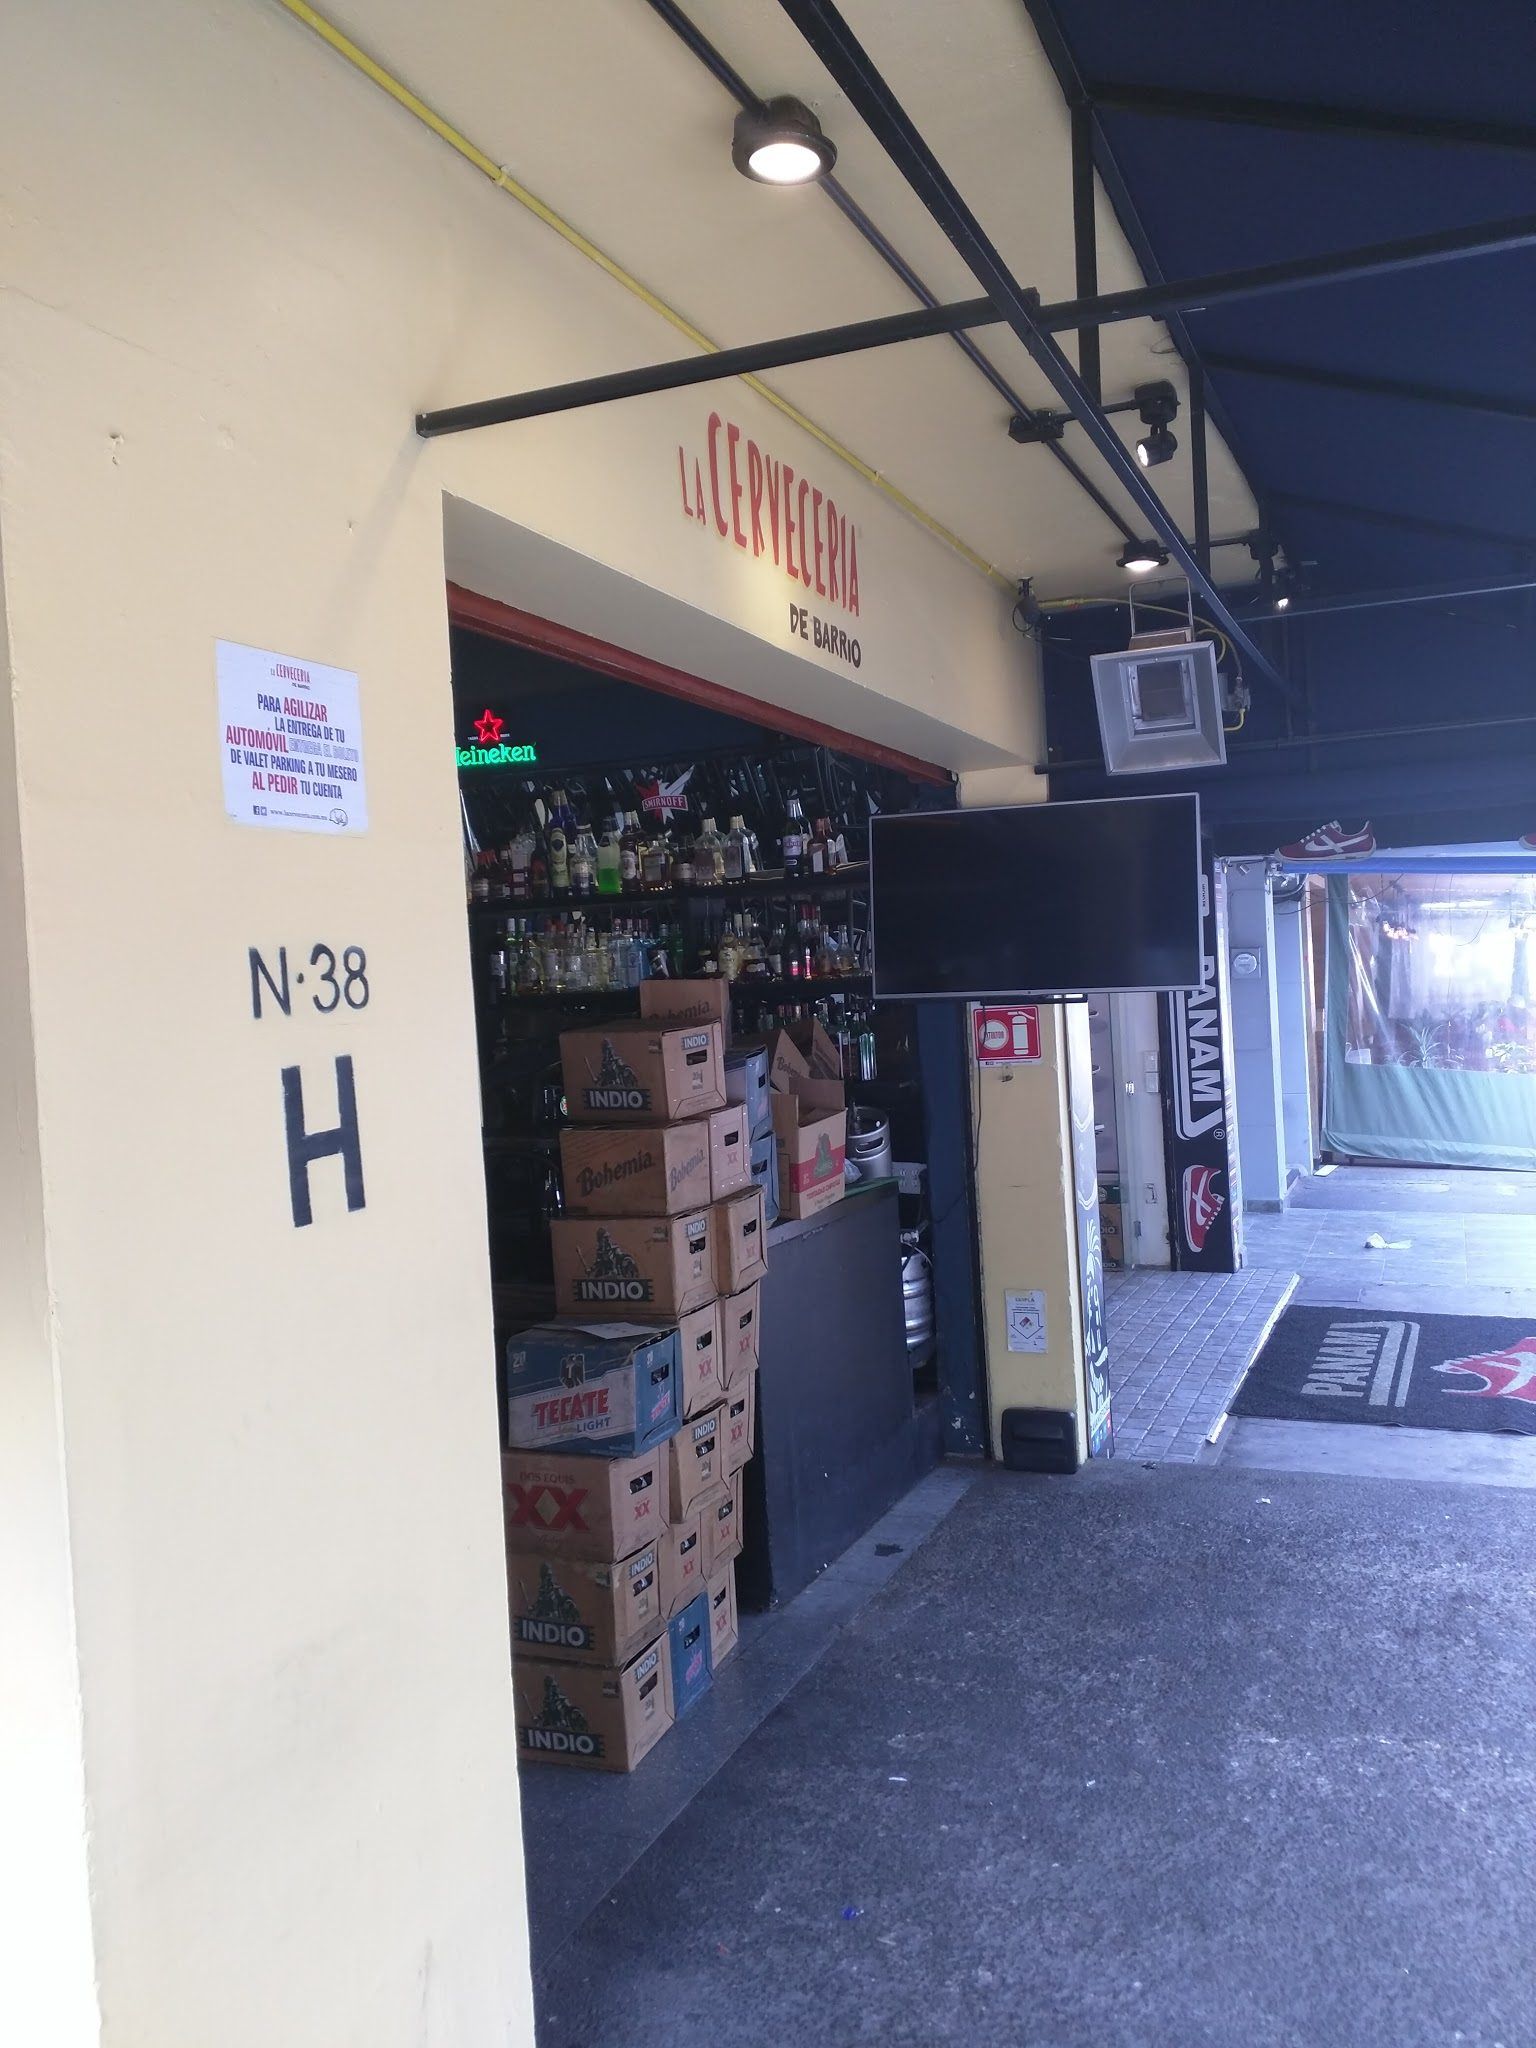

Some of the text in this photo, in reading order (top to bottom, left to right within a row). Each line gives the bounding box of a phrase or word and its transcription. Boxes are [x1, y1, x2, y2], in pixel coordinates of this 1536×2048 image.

[679, 411, 860, 617] LA CERVECERIA
[790, 602, 862, 668] DE BARRIO
[257, 693, 328, 722] PARA AGILIZAR
[226, 725, 289, 753] AUTOMÓVIL
[274, 717, 345, 743] LA ENTREGA DE TU
[230, 748, 358, 782] DE VALET PARKING A TU MESERO
[252, 771, 343, 800] AL PEDIR TU CUENTA
[644, 796, 686, 810] SMIRNOFF
[684, 1035, 707, 1049] INDIO
[589, 1090, 644, 1109] INDIO
[282, 1055, 366, 1228] H
[576, 1149, 654, 1197] Bohemia
[670, 1149, 706, 1191] Bohemia
[687, 1219, 706, 1236] INDIO
[581, 1280, 645, 1301] INDIO
[698, 1359, 712, 1375] XX
[1300, 1330, 1381, 1398] PANAM
[534, 1387, 610, 1429] TECATE
[577, 1415, 611, 1433] LIGHT
[695, 1420, 716, 1440] INDIO
[731, 1423, 744, 1442] XX
[505, 1482, 589, 1532] XX
[634, 1499, 652, 1520] XX
[631, 1553, 654, 1576] INDIO
[683, 1560, 695, 1578] XX
[521, 1618, 586, 1648] INDIO
[635, 1652, 658, 1680] INDIO
[527, 1727, 594, 1755] INDIO
